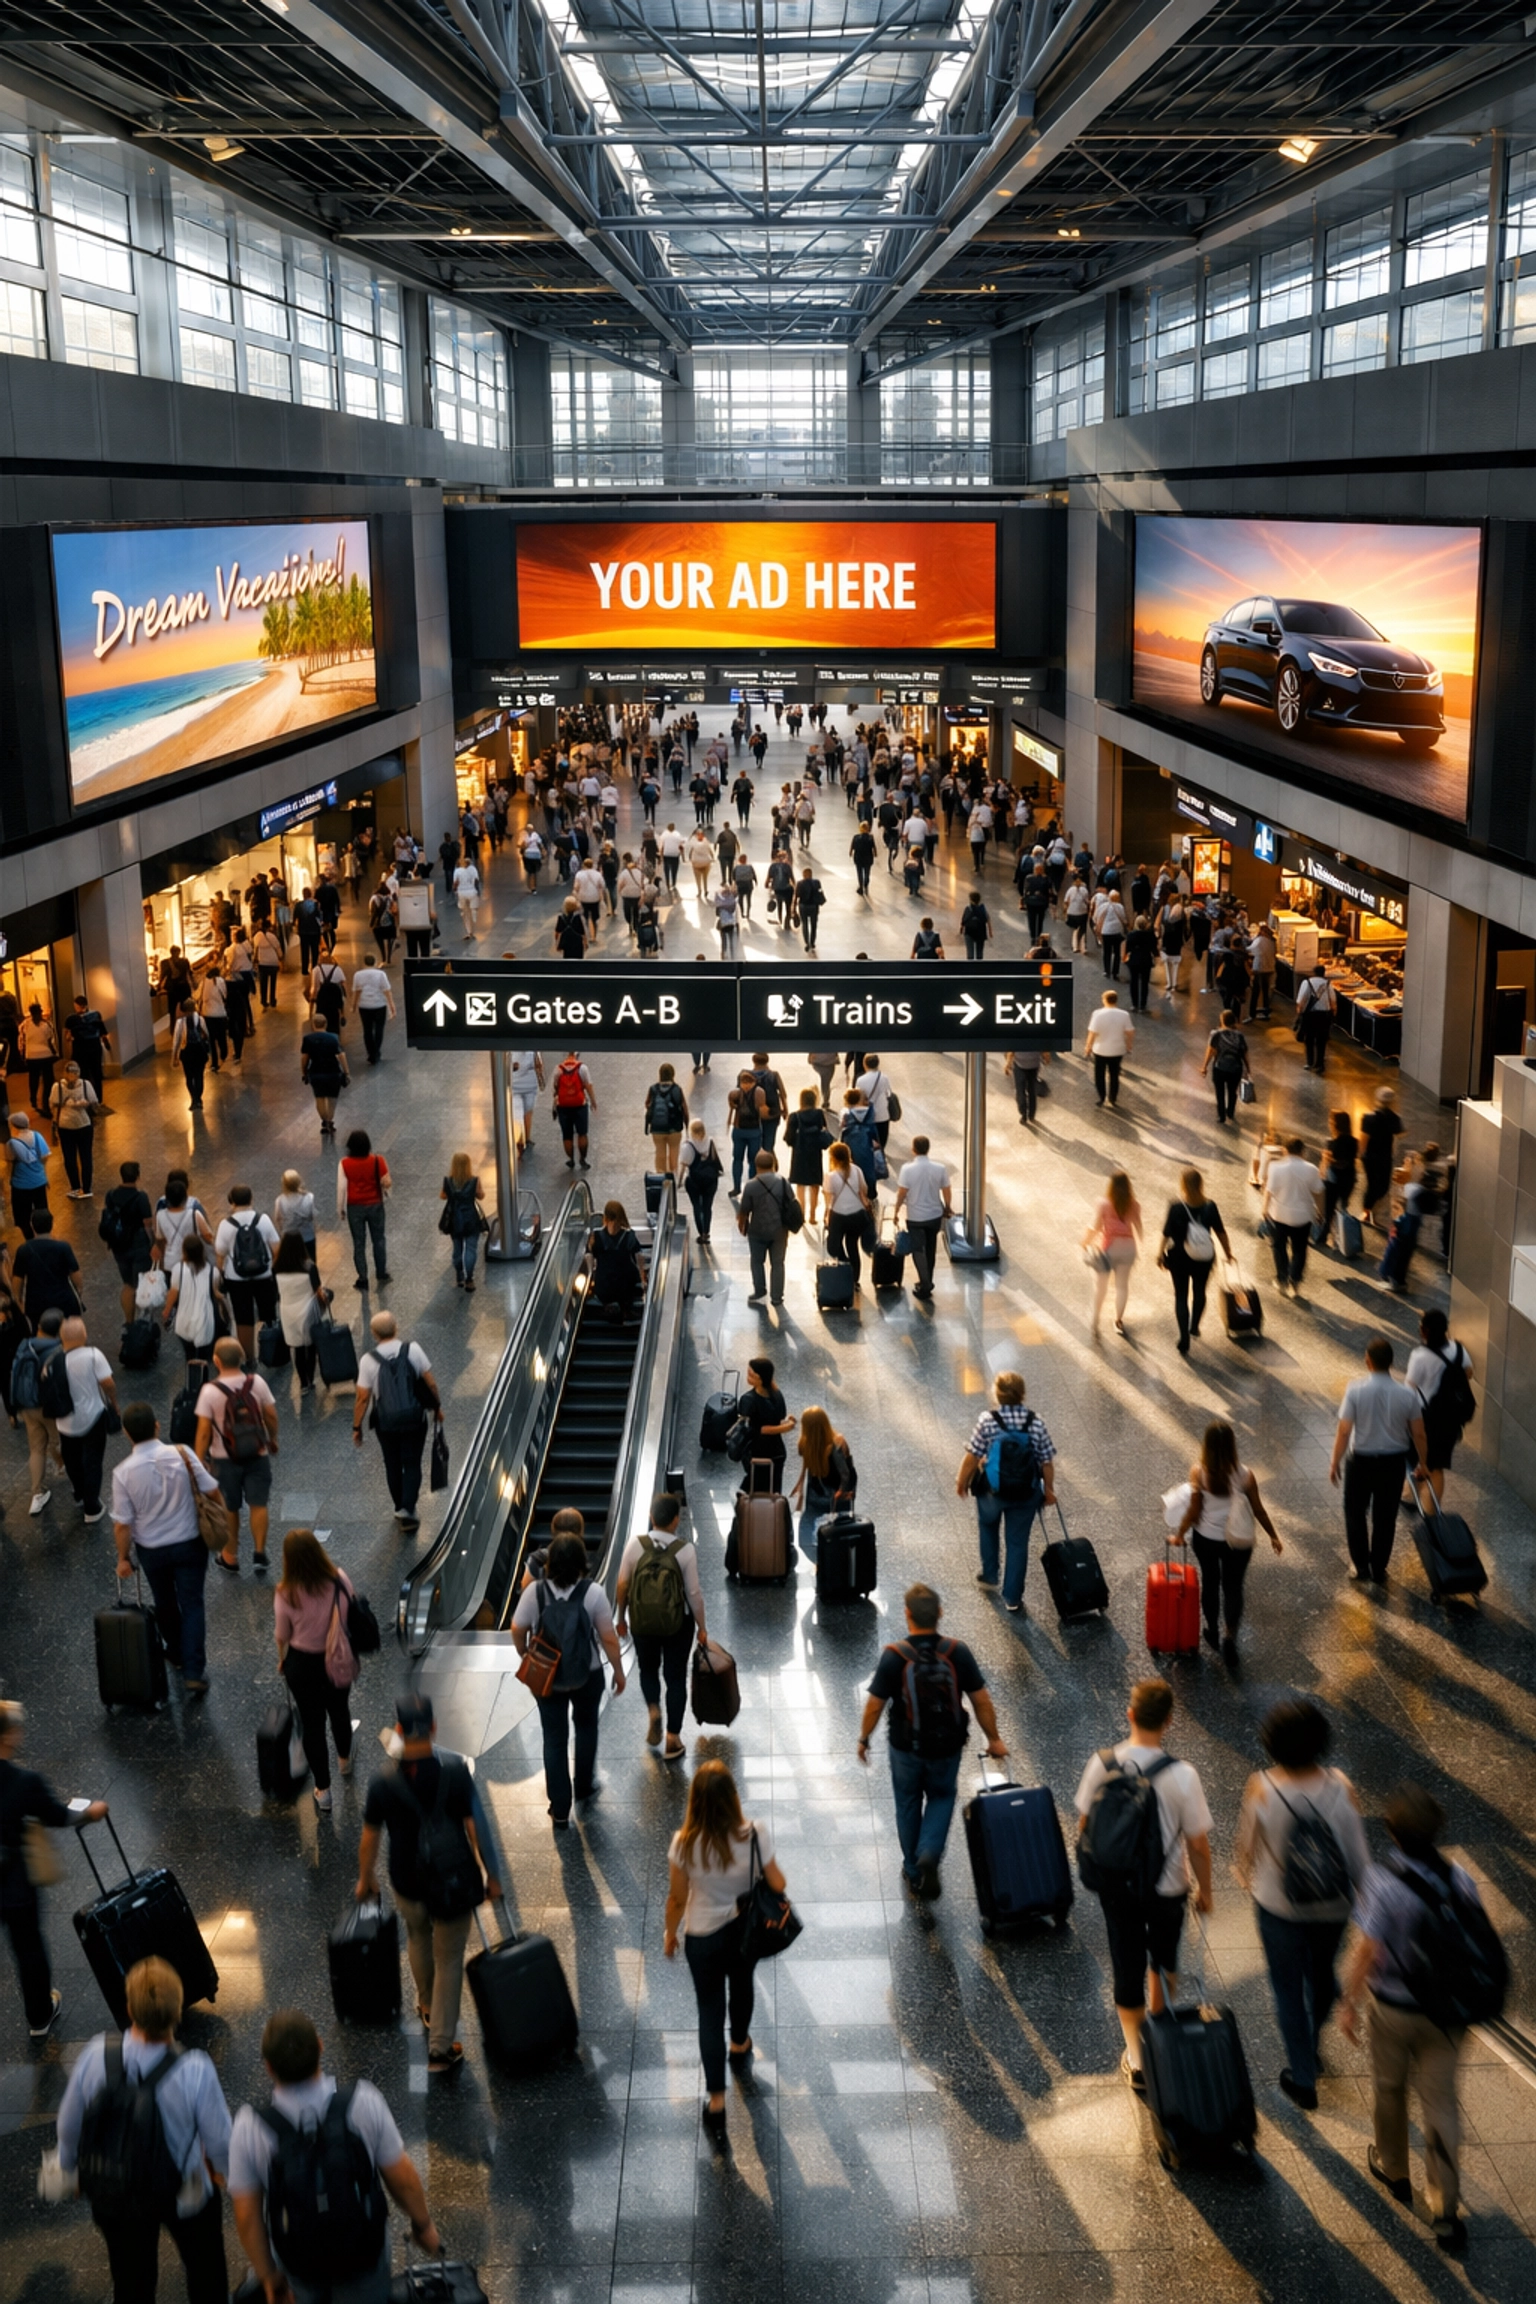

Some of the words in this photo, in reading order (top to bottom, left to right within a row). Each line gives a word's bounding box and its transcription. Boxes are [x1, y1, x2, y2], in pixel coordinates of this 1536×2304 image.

[589, 561, 715, 610] YOUR
[727, 561, 789, 610] AD
[805, 561, 917, 610] HERE
[91, 589, 211, 659] Dream
[506, 993, 603, 1025] Gates
[614, 994, 681, 1025] A-B
[812, 994, 913, 1025] Trains
[995, 993, 1056, 1025] Exit
